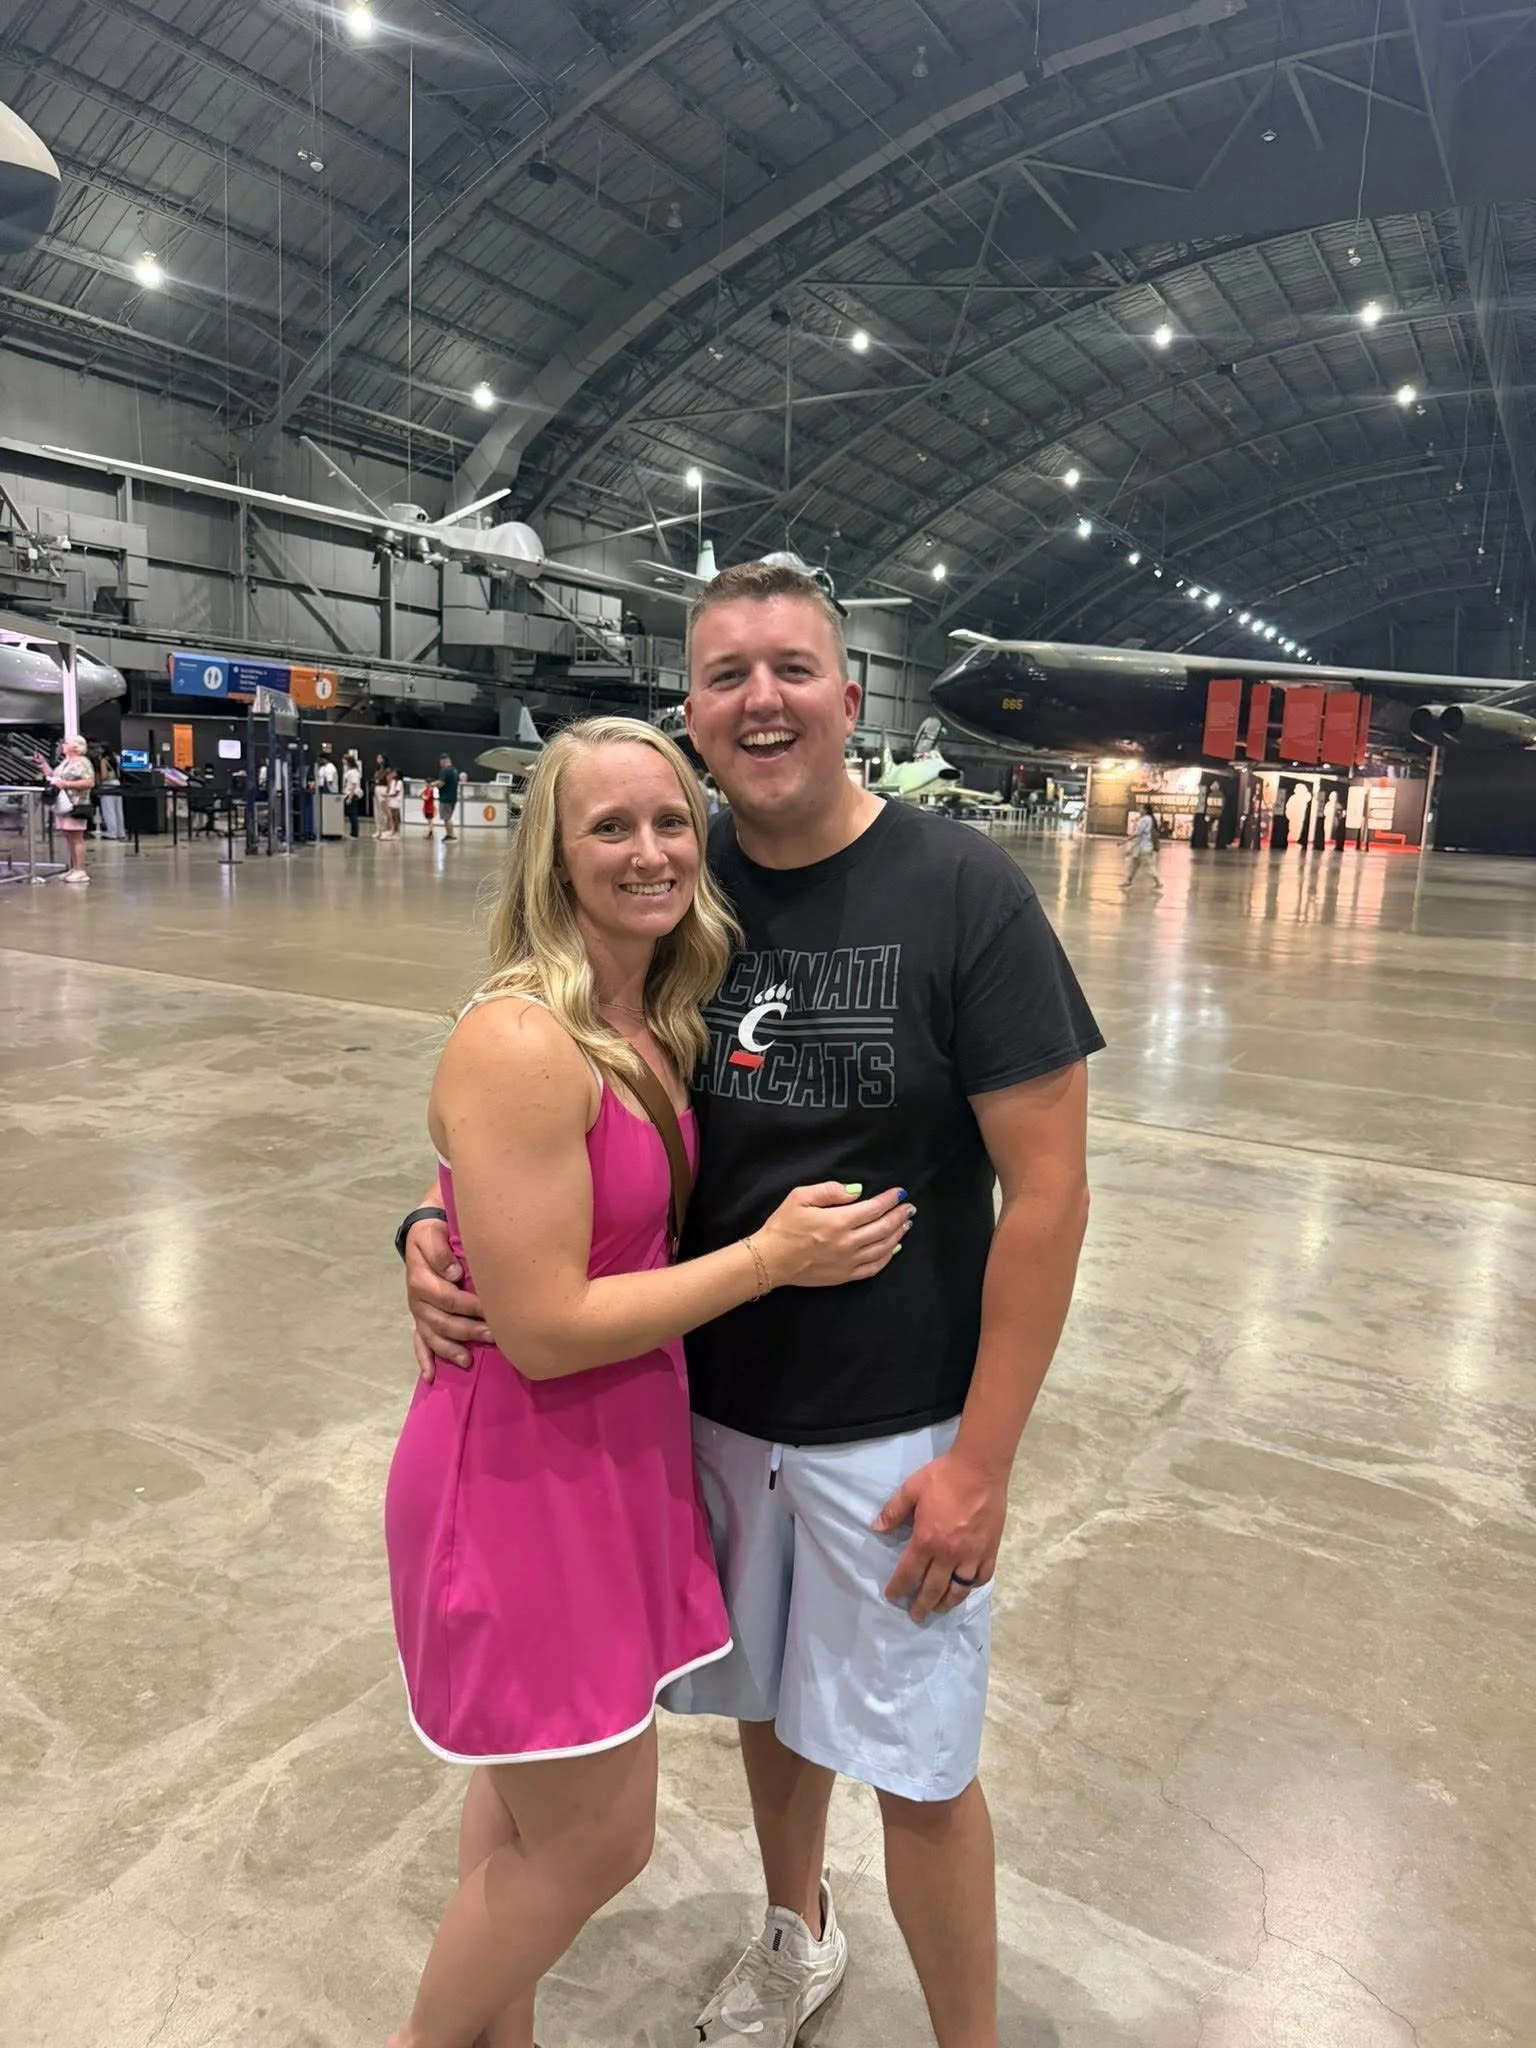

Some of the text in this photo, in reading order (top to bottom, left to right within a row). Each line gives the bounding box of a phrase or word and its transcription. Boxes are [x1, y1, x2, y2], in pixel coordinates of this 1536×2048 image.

[1002, 698, 1024, 710] 665
[717, 944, 901, 1011] CINNATI
[692, 1030, 895, 1108] ARCATS
